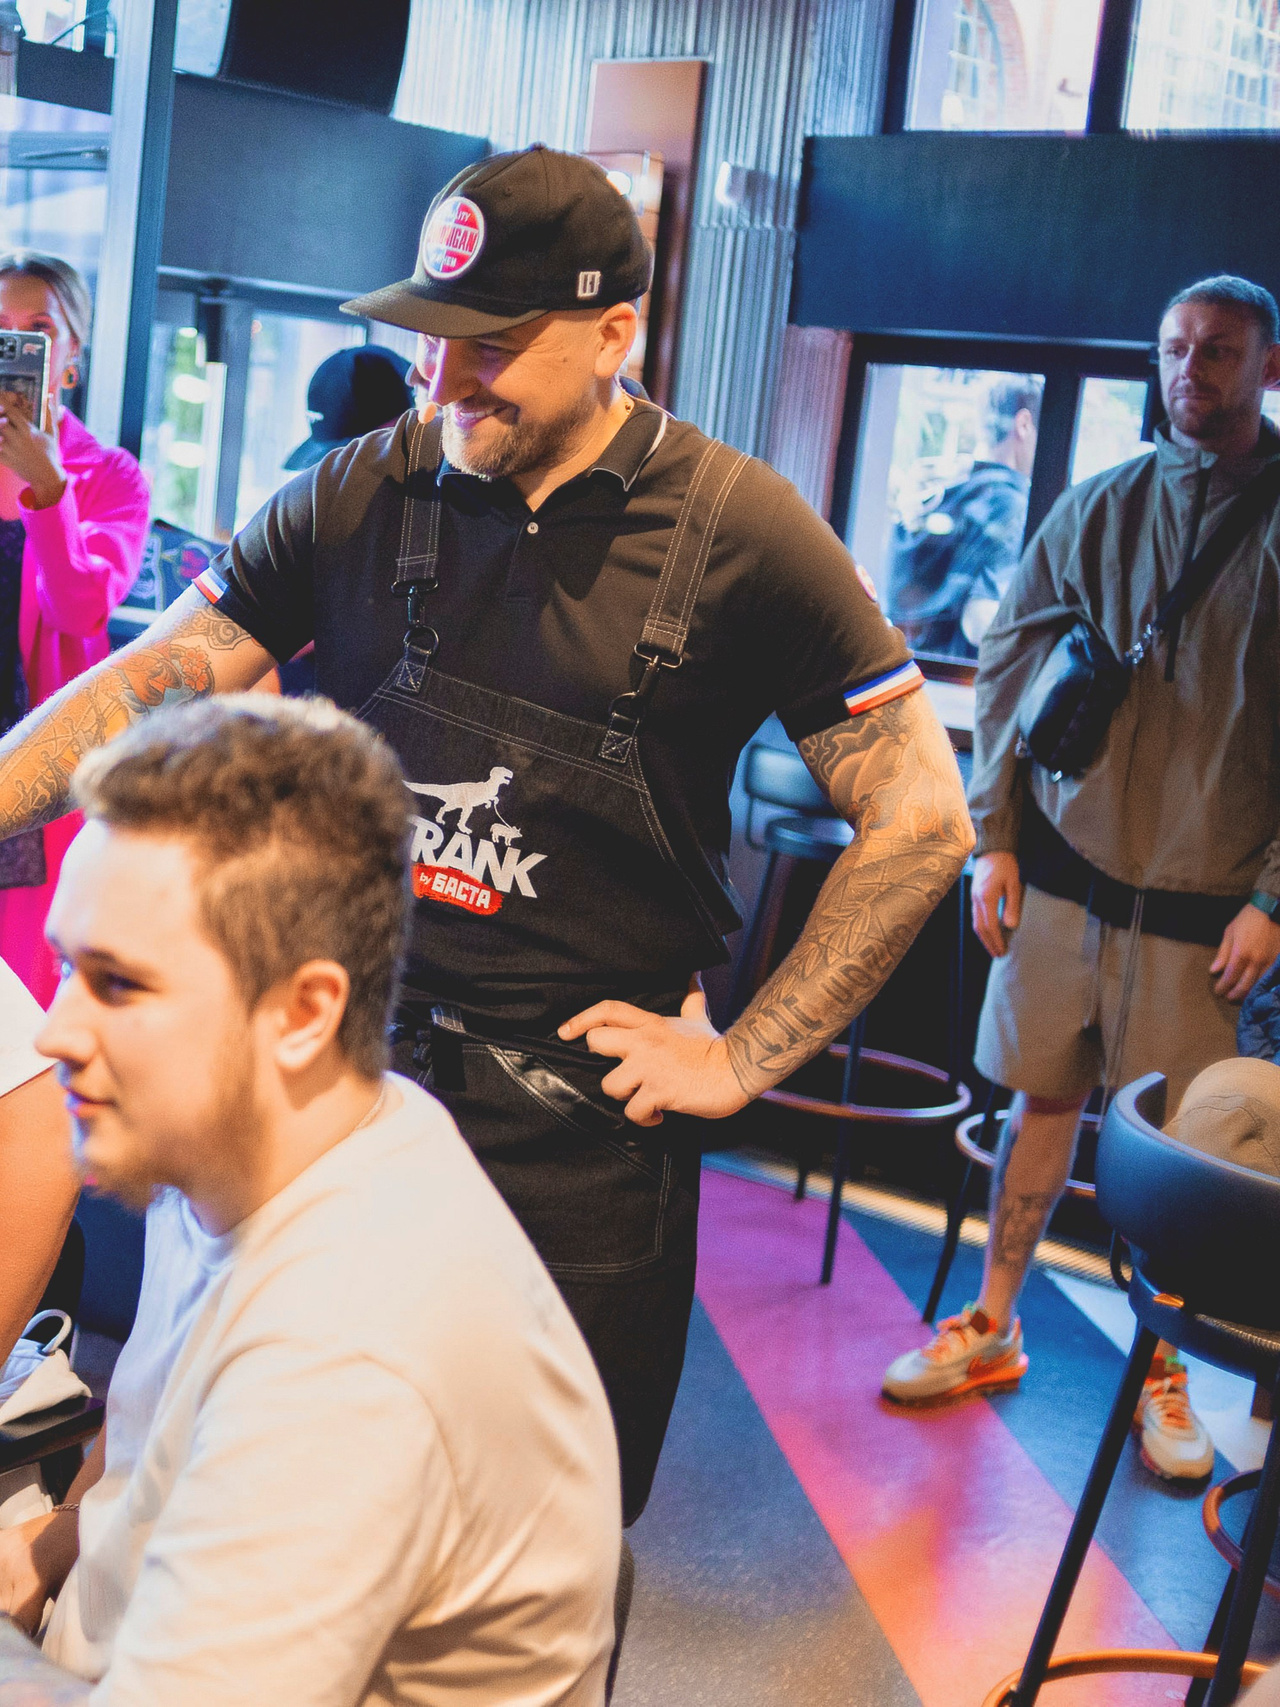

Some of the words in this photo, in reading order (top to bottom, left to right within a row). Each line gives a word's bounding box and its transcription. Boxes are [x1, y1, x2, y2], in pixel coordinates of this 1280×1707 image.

[427, 223, 478, 252] ONIGAN
[408, 813, 548, 898] RANK
[419, 872, 433, 885] by
[431, 872, 491, 909] БАСТА
